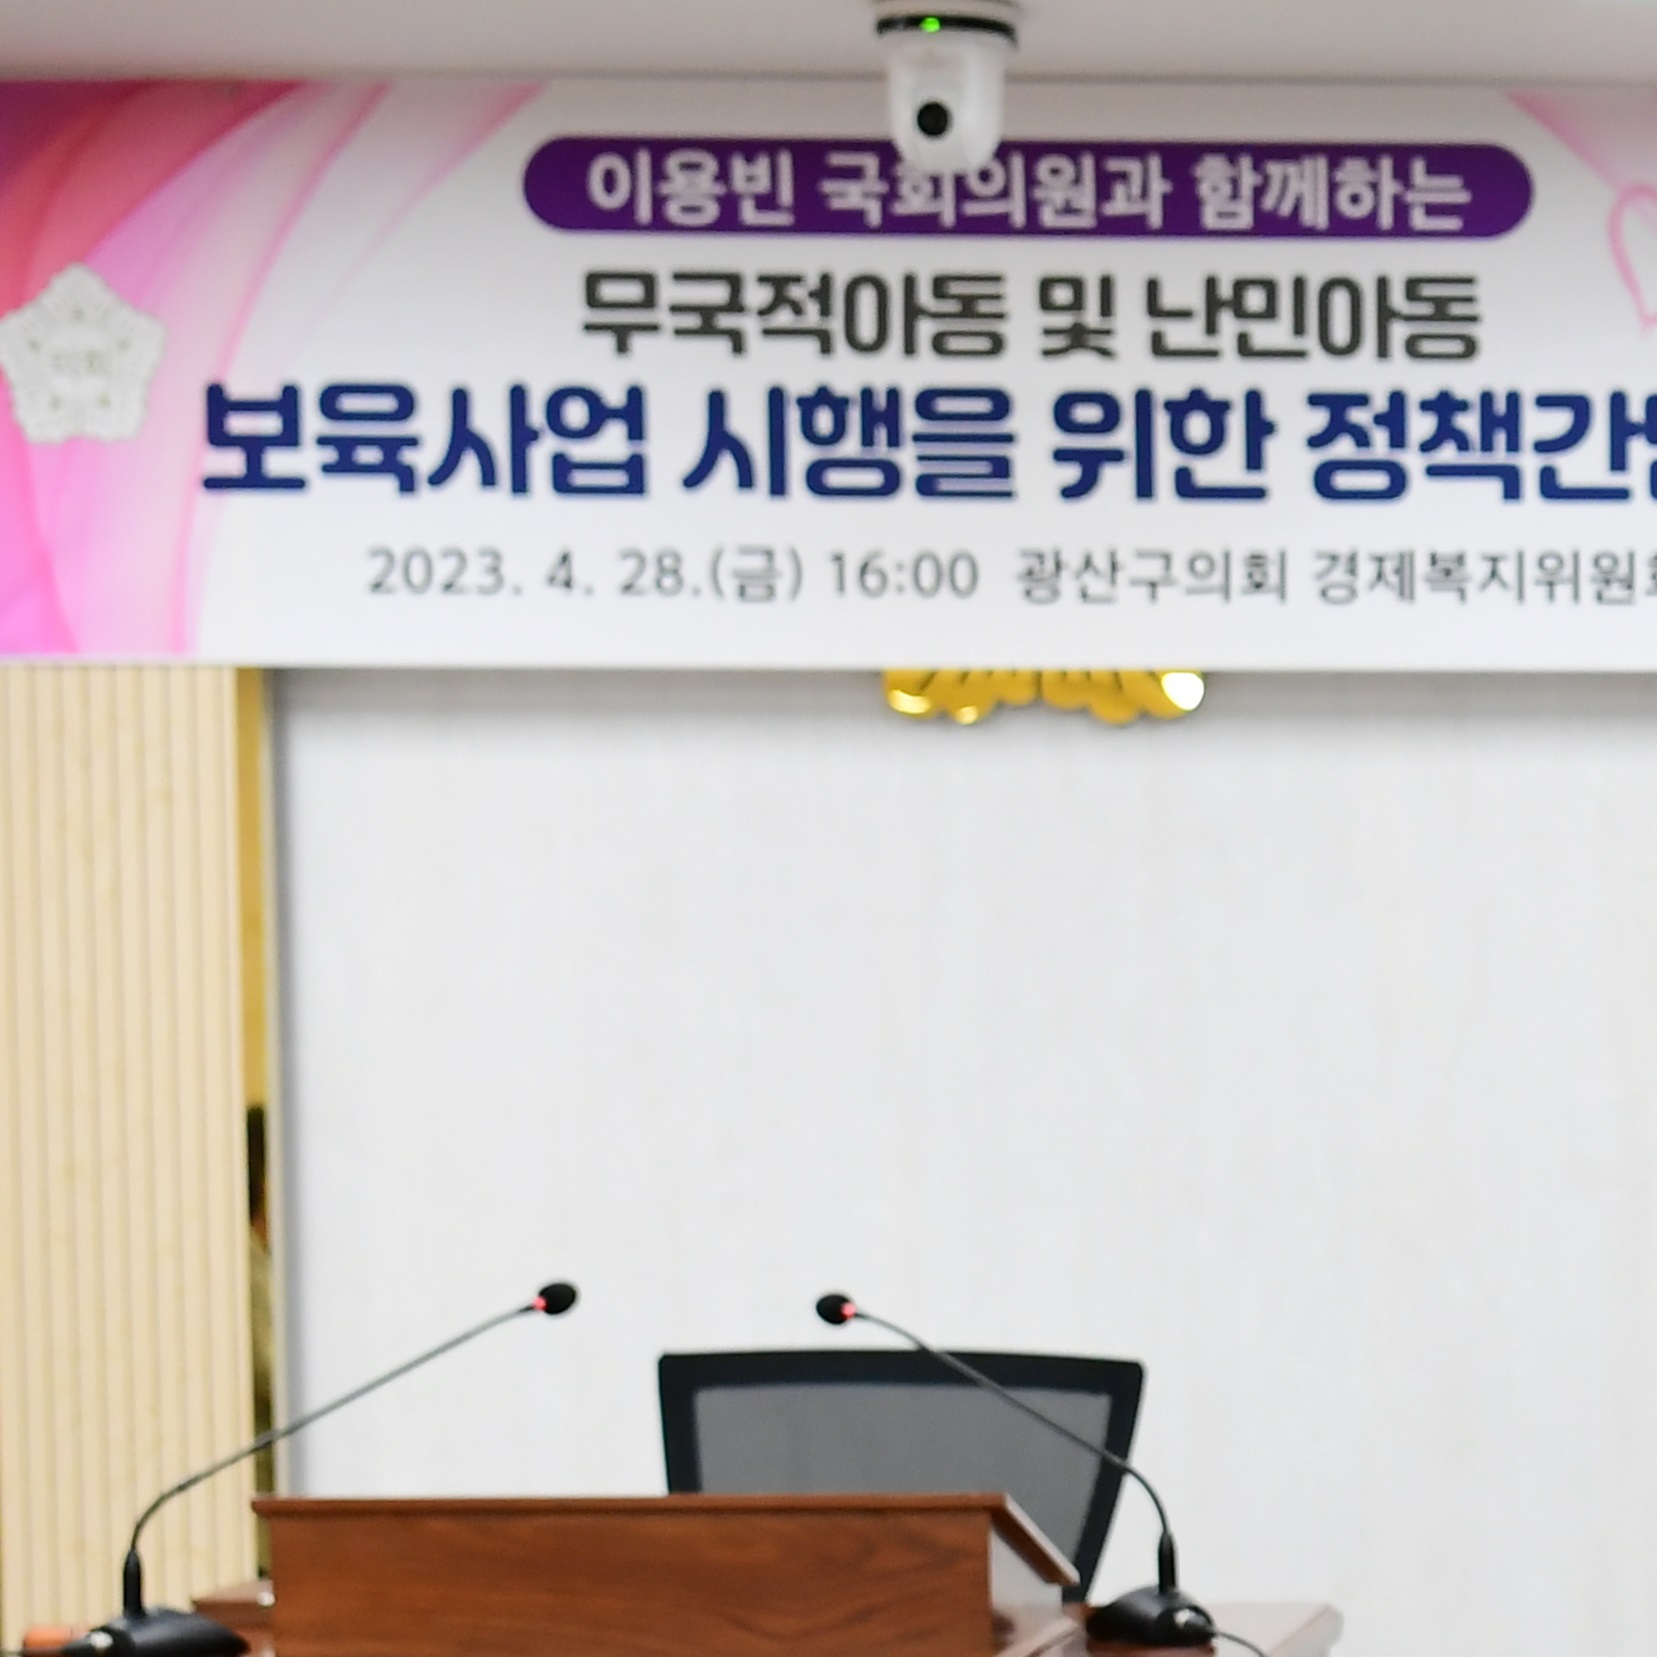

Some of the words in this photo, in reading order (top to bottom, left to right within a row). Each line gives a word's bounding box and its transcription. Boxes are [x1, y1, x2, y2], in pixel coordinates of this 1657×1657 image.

[586, 149, 796, 227] 이용빈
[819, 150, 1172, 231] 국회의원과
[1193, 155, 1473, 232] 함께하는
[582, 269, 1007, 359] 무국적아동
[1037, 274, 1116, 360] 및
[1145, 274, 1481, 362] 난민아동
[201, 381, 648, 498] 보육사업
[681, 384, 1017, 500] 시행을
[1051, 386, 1277, 502] 위한
[369, 547, 524, 596] 2023.
[545, 549, 595, 596] 4.
[618, 545, 805, 605] 28.(금)
[829, 549, 980, 599] 16:00
[1016, 547, 1288, 606] 광산구의회
